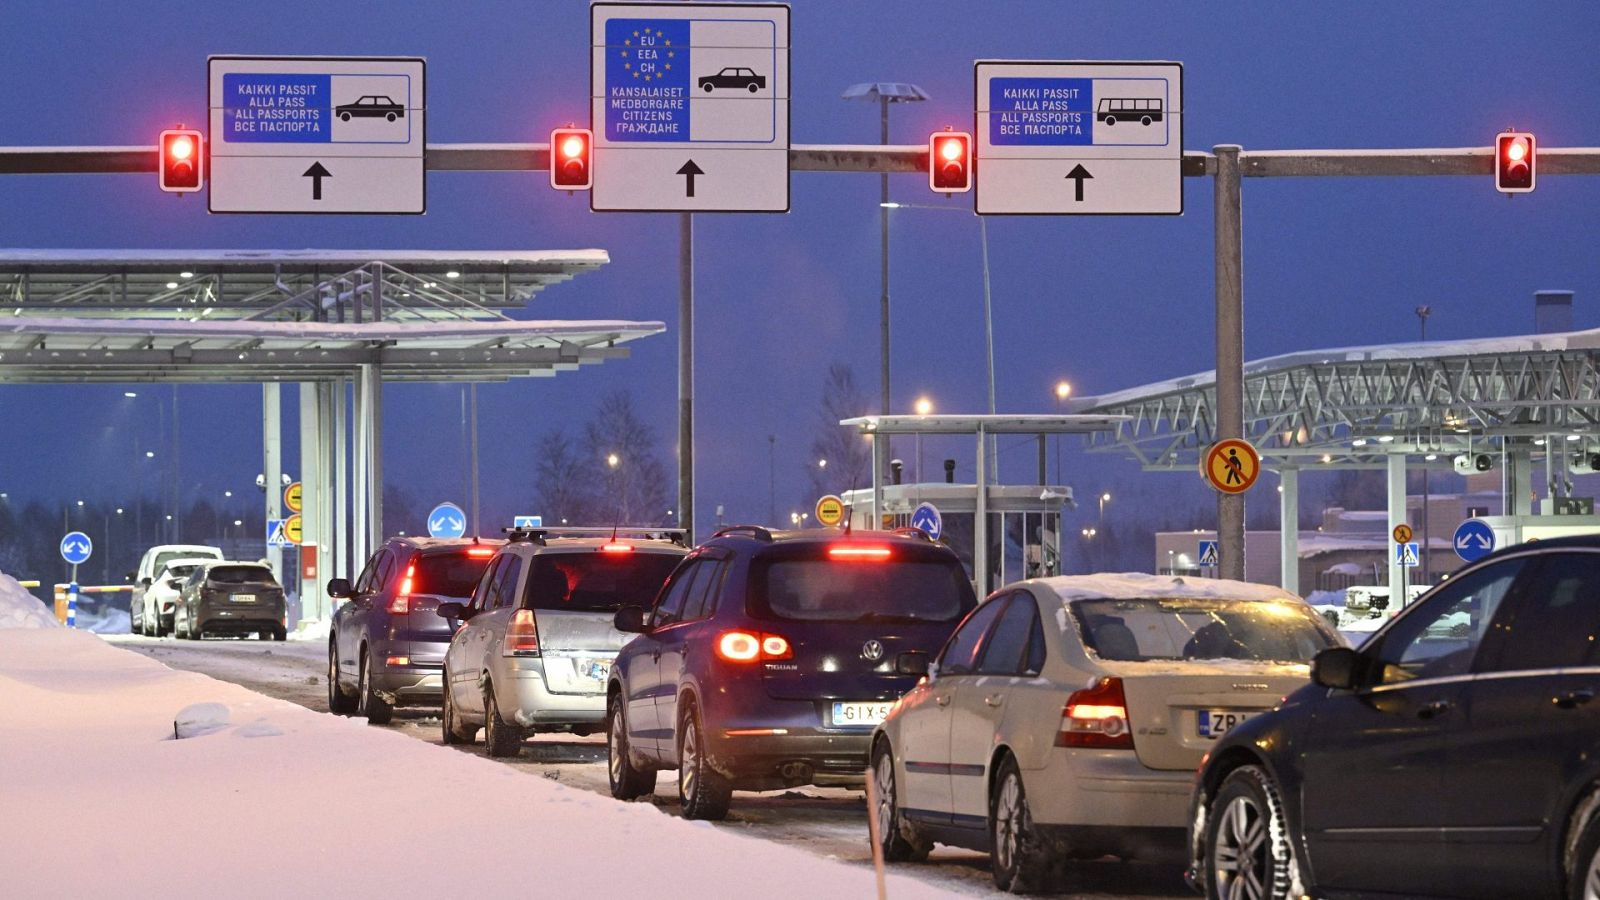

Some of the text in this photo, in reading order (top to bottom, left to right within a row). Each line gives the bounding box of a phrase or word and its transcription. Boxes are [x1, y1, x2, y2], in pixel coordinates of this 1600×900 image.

[641, 37, 655, 46] EU
[638, 50, 658, 59] EEA
[640, 63, 655, 73] CH
[238, 85, 317, 95] KAIKKI PASSIT
[612, 88, 683, 97] KANSALAISET
[1004, 89, 1080, 99] KAIKKI PASSIT
[249, 97, 305, 107] ALLA PASS
[612, 100, 683, 109] MEDBORGARE
[1014, 101, 1068, 111] ALLA PASS
[235, 109, 320, 120] ALL PASSPORTS
[623, 111, 672, 121] CITIZENS
[1001, 113, 1081, 123] ALL PASSPORTS
[234, 122, 320, 132] ВСЕ ПАСПОРТА
[616, 123, 679, 134] ГРАЖДАНЕ
[1000, 125, 1082, 135] ВСЕ ПАСПОРТА
